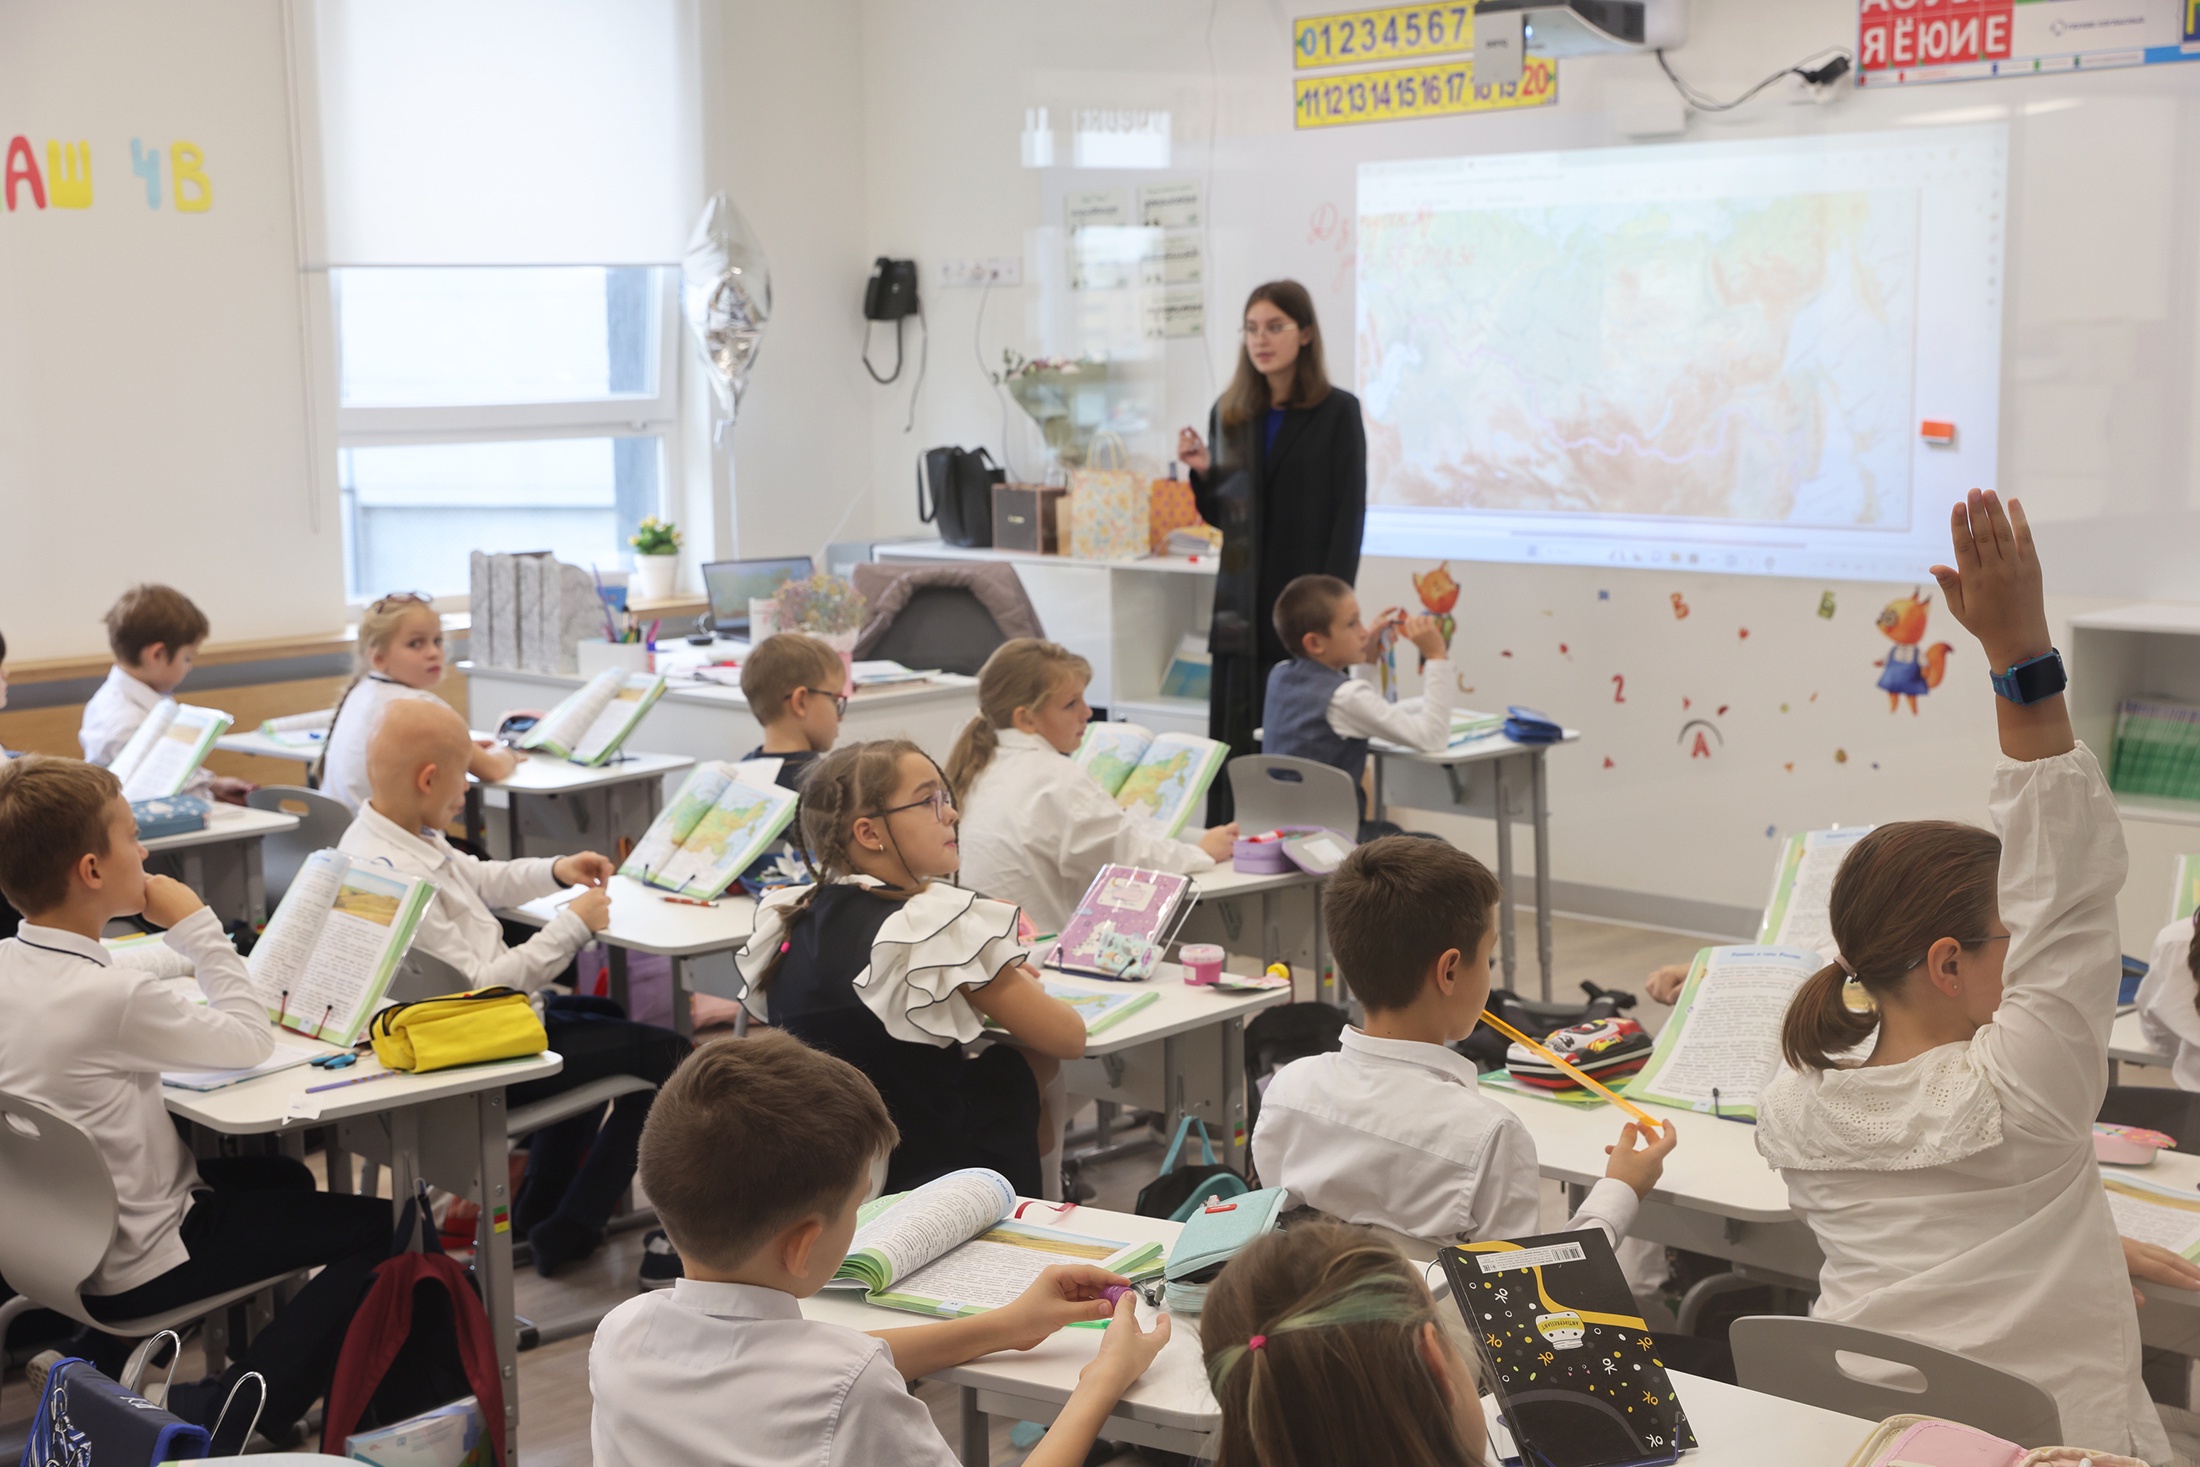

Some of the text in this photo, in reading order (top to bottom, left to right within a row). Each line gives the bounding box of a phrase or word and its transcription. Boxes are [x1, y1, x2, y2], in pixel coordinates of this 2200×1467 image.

[1301, 8, 1467, 56] 0 1 2 3 4 5 6 7
[1304, 88, 1320, 118] 11
[1323, 86, 1342, 116] 12
[1347, 83, 1366, 113] 13
[1371, 81, 1390, 110] 14
[1395, 78, 1416, 107] 15
[1420, 75, 1441, 105] 16
[1446, 73, 1465, 104] 17
[1522, 64, 1548, 97] 20
[0, 132, 213, 213] АШ 4В
[1611, 674, 1625, 704] 2
[1494, 1287, 1509, 1304] OK
[1486, 1333, 1503, 1349] OK
[1636, 1336, 1653, 1352] OK
[1537, 1351, 1555, 1367] OK
[1602, 1358, 1618, 1375] OK
[1642, 1390, 1659, 1406] OK
[1645, 1433, 1664, 1448] OK
